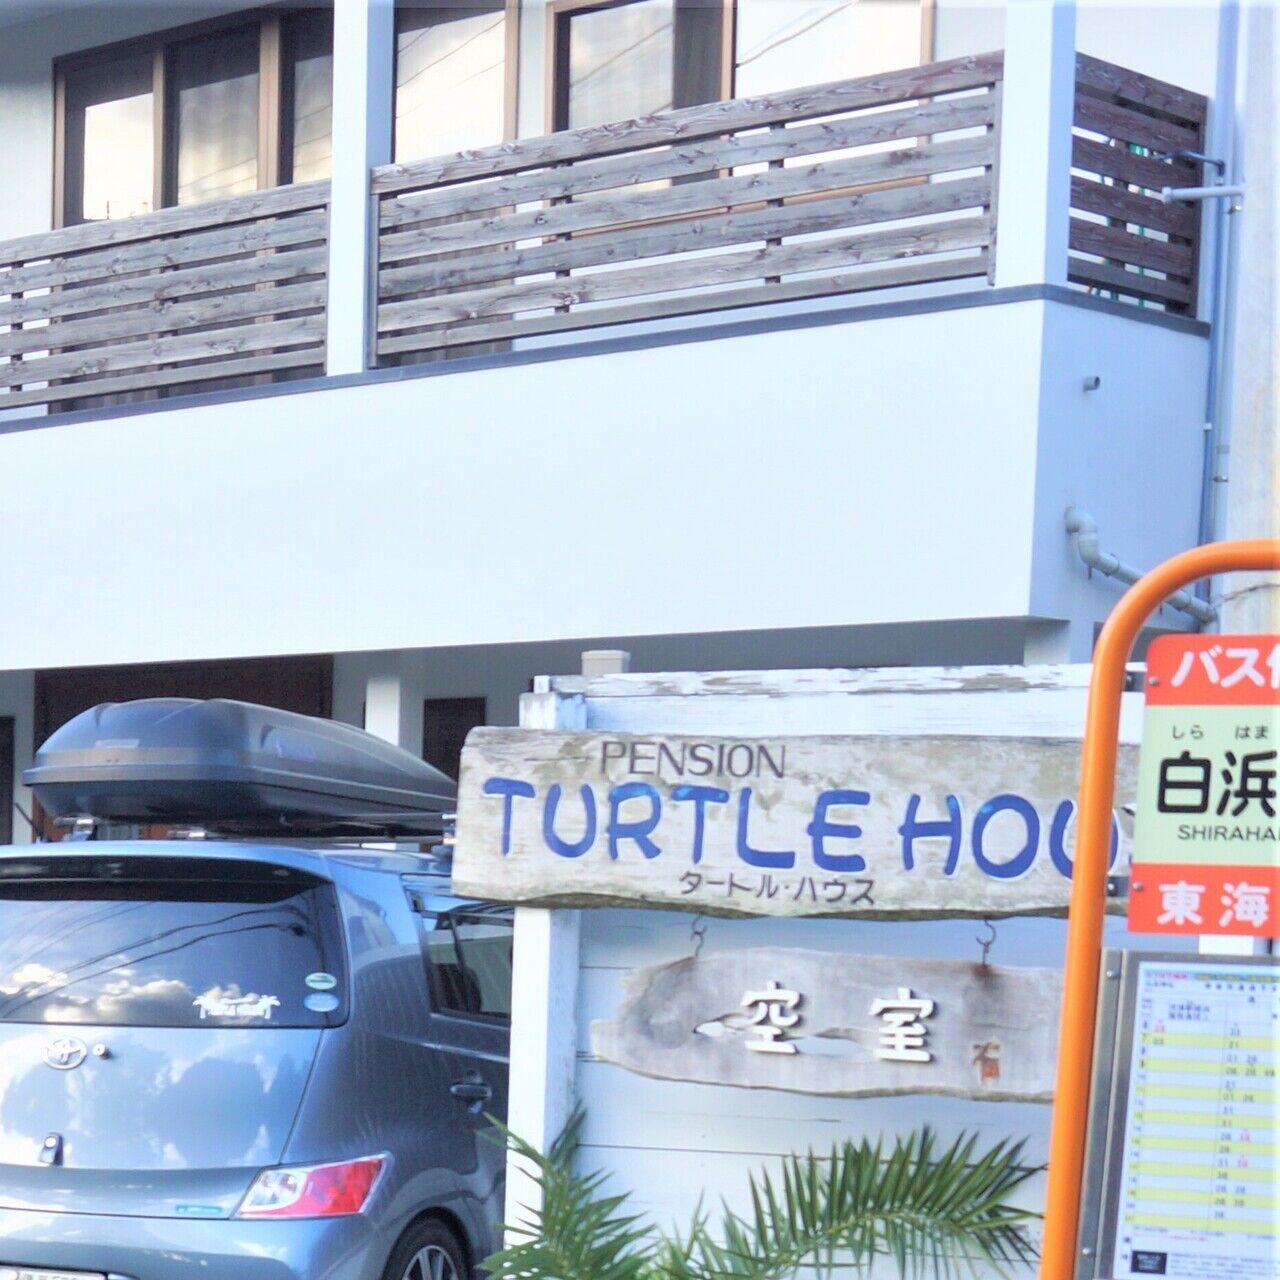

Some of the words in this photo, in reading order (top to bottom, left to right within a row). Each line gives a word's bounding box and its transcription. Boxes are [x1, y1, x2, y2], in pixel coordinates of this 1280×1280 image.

[600, 741, 786, 779] PENSION
[1157, 750, 1278, 818] 白浜
[483, 777, 872, 873] TURTLE
[897, 793, 1132, 881] HOU
[1178, 824, 1280, 842] SHIRAHA
[678, 870, 876, 906] タートル・ハウス
[1157, 880, 1270, 927] 東海
